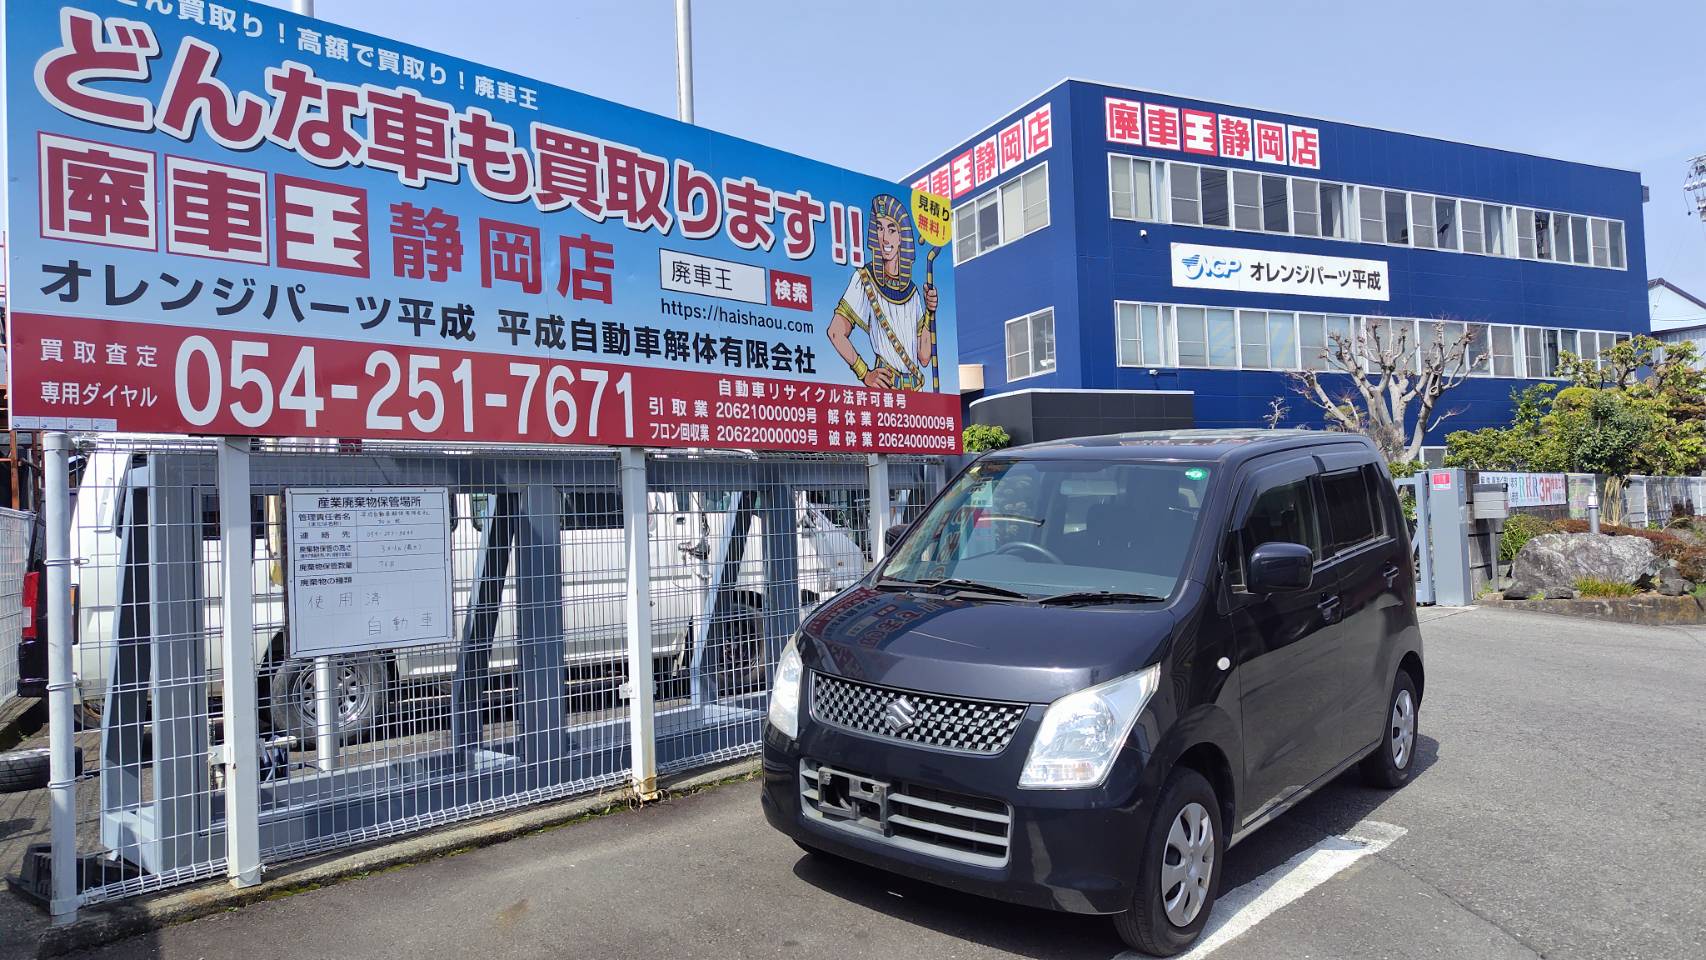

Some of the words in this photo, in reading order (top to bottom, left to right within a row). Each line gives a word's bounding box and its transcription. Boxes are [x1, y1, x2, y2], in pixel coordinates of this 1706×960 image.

[1106, 99, 1319, 168] 廃車王静岡店
[918, 194, 950, 222] 見積り
[672, 260, 733, 291] 廃車王
[775, 278, 809, 304] 検索
[1250, 262, 1381, 290] オレンジパーツ平成
[40, 259, 475, 342] オレンジパーツ平成
[497, 309, 816, 374] 平成自動車解体有限会社
[661, 298, 814, 334] https://haishaou.com
[40, 338, 158, 368] 買取査定
[40, 381, 158, 408] 専用ダイヤル
[174, 334, 634, 438] 054-251-7671
[718, 378, 908, 409] 自動車リサイクル法許可番号
[649, 397, 709, 418] 引取業
[716, 402, 818, 424] 20621000009号
[877, 412, 954, 431] 20623000009号
[649, 423, 710, 442] フロン回収業
[717, 425, 818, 446] 20622000009号
[878, 432, 956, 450] 20624000009号
[317, 496, 421, 509] 産業廃棄物保管場所
